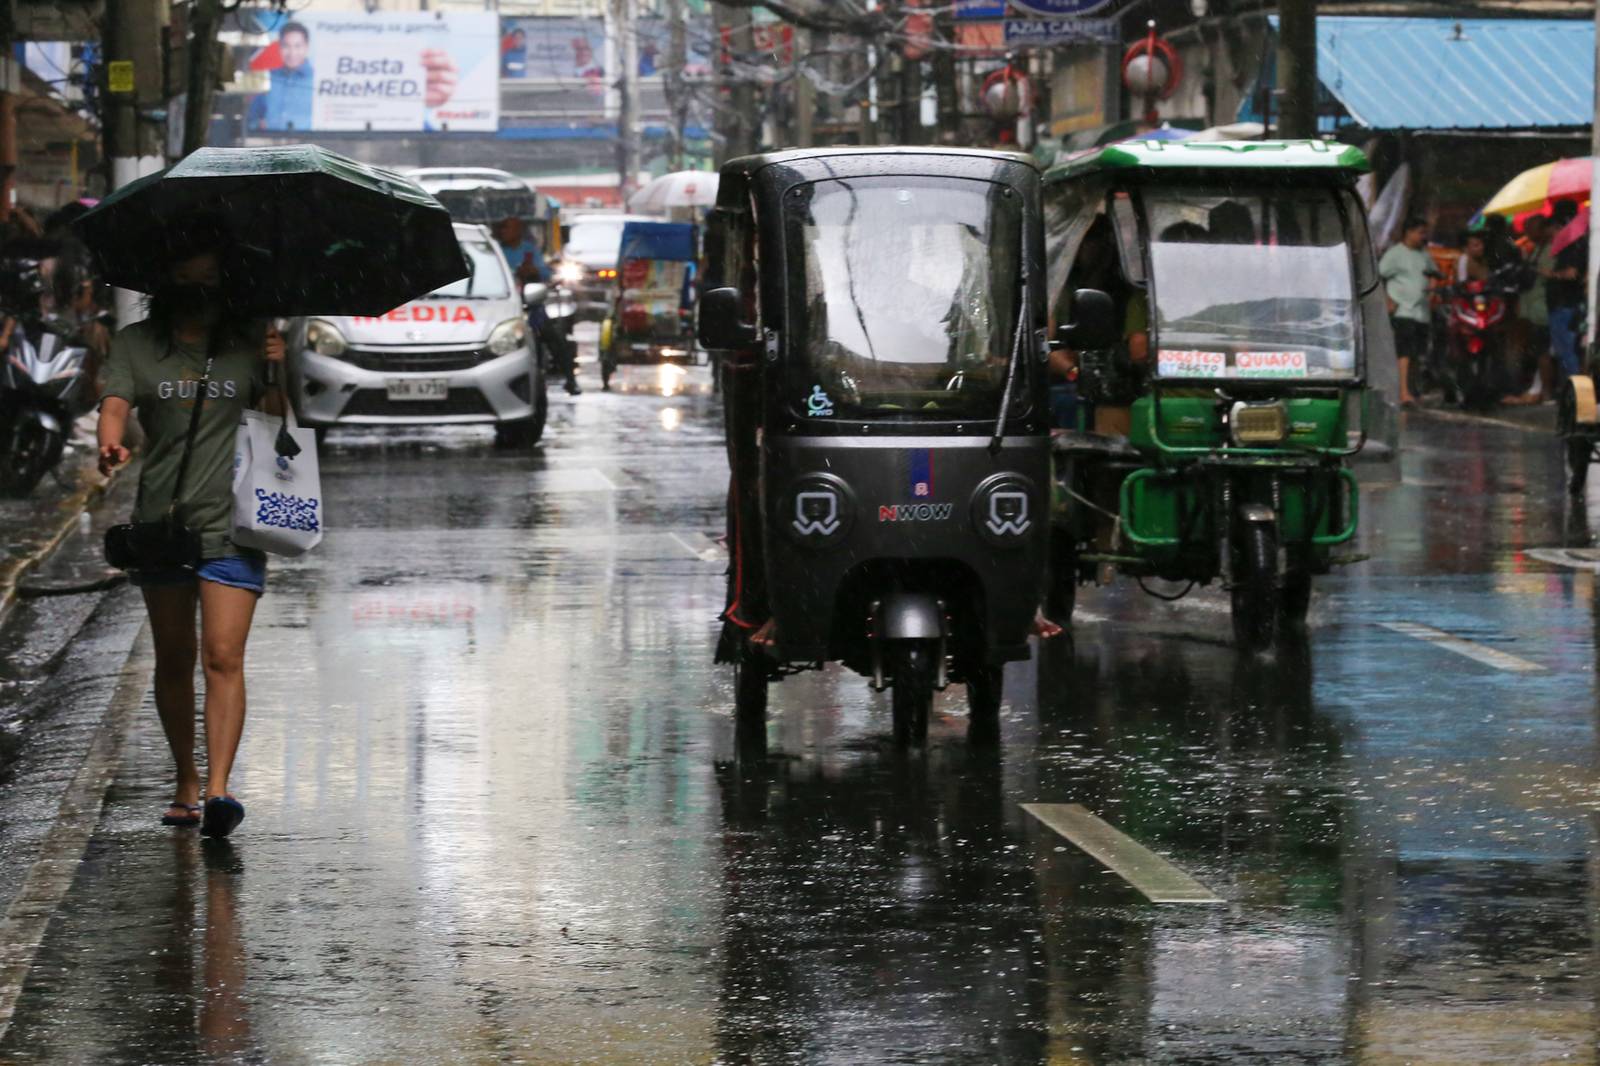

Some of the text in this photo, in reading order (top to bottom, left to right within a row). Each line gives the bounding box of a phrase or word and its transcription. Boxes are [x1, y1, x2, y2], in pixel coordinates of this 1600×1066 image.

[336, 56, 404, 75] Basta
[318, 79, 422, 98] RiteMED.
[1238, 352, 1302, 368] QUIAPO
[808, 409, 834, 417] PWD
[879, 502, 954, 522] NWOW
